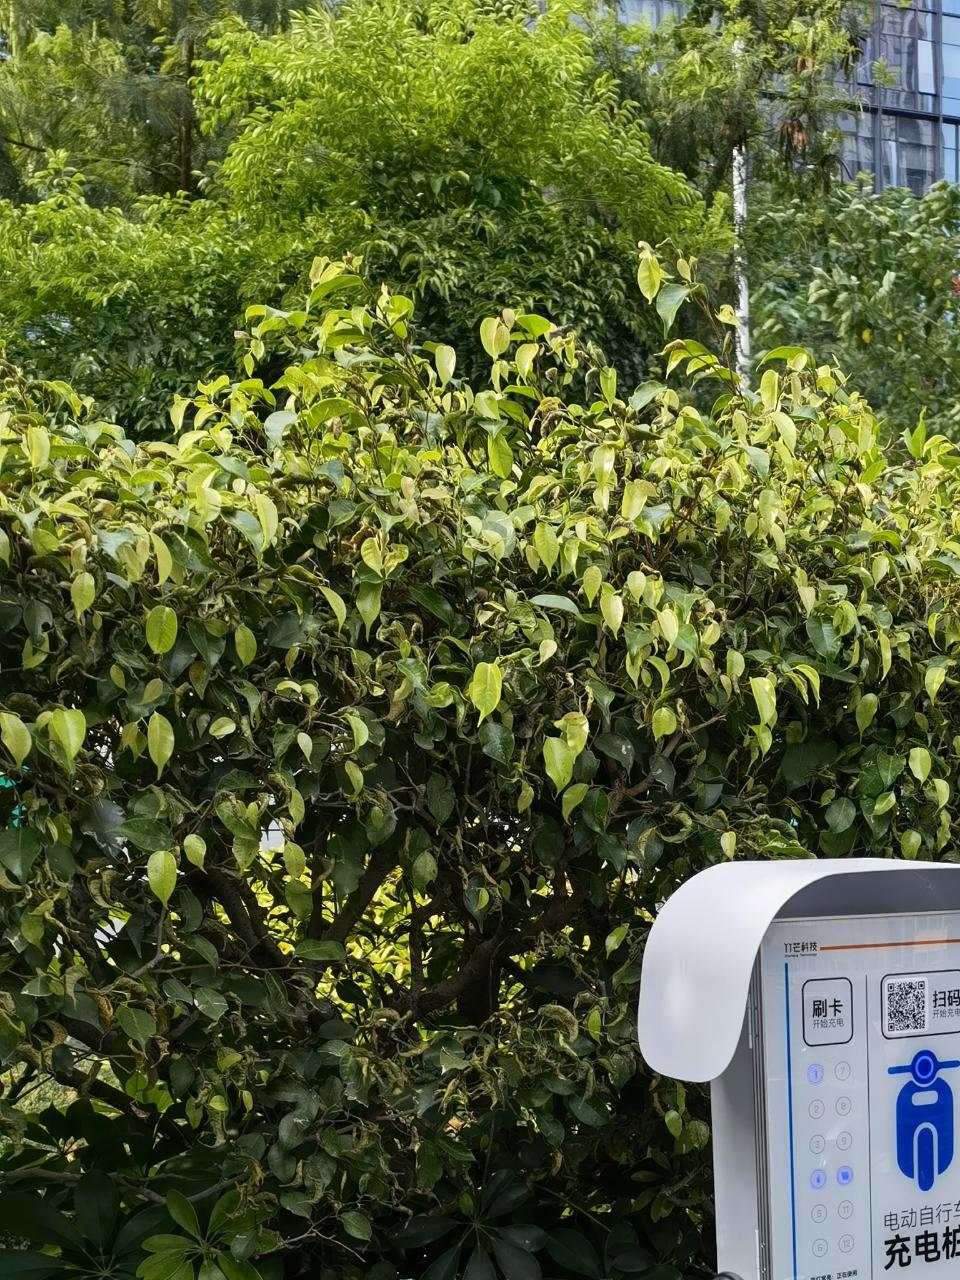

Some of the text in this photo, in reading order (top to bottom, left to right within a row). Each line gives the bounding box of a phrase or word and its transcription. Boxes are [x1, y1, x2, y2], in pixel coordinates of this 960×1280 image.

[812, 998, 844, 1018] 刷卡
[932, 989, 960, 1008] 扫码
[812, 1018, 844, 1029] 开始充电
